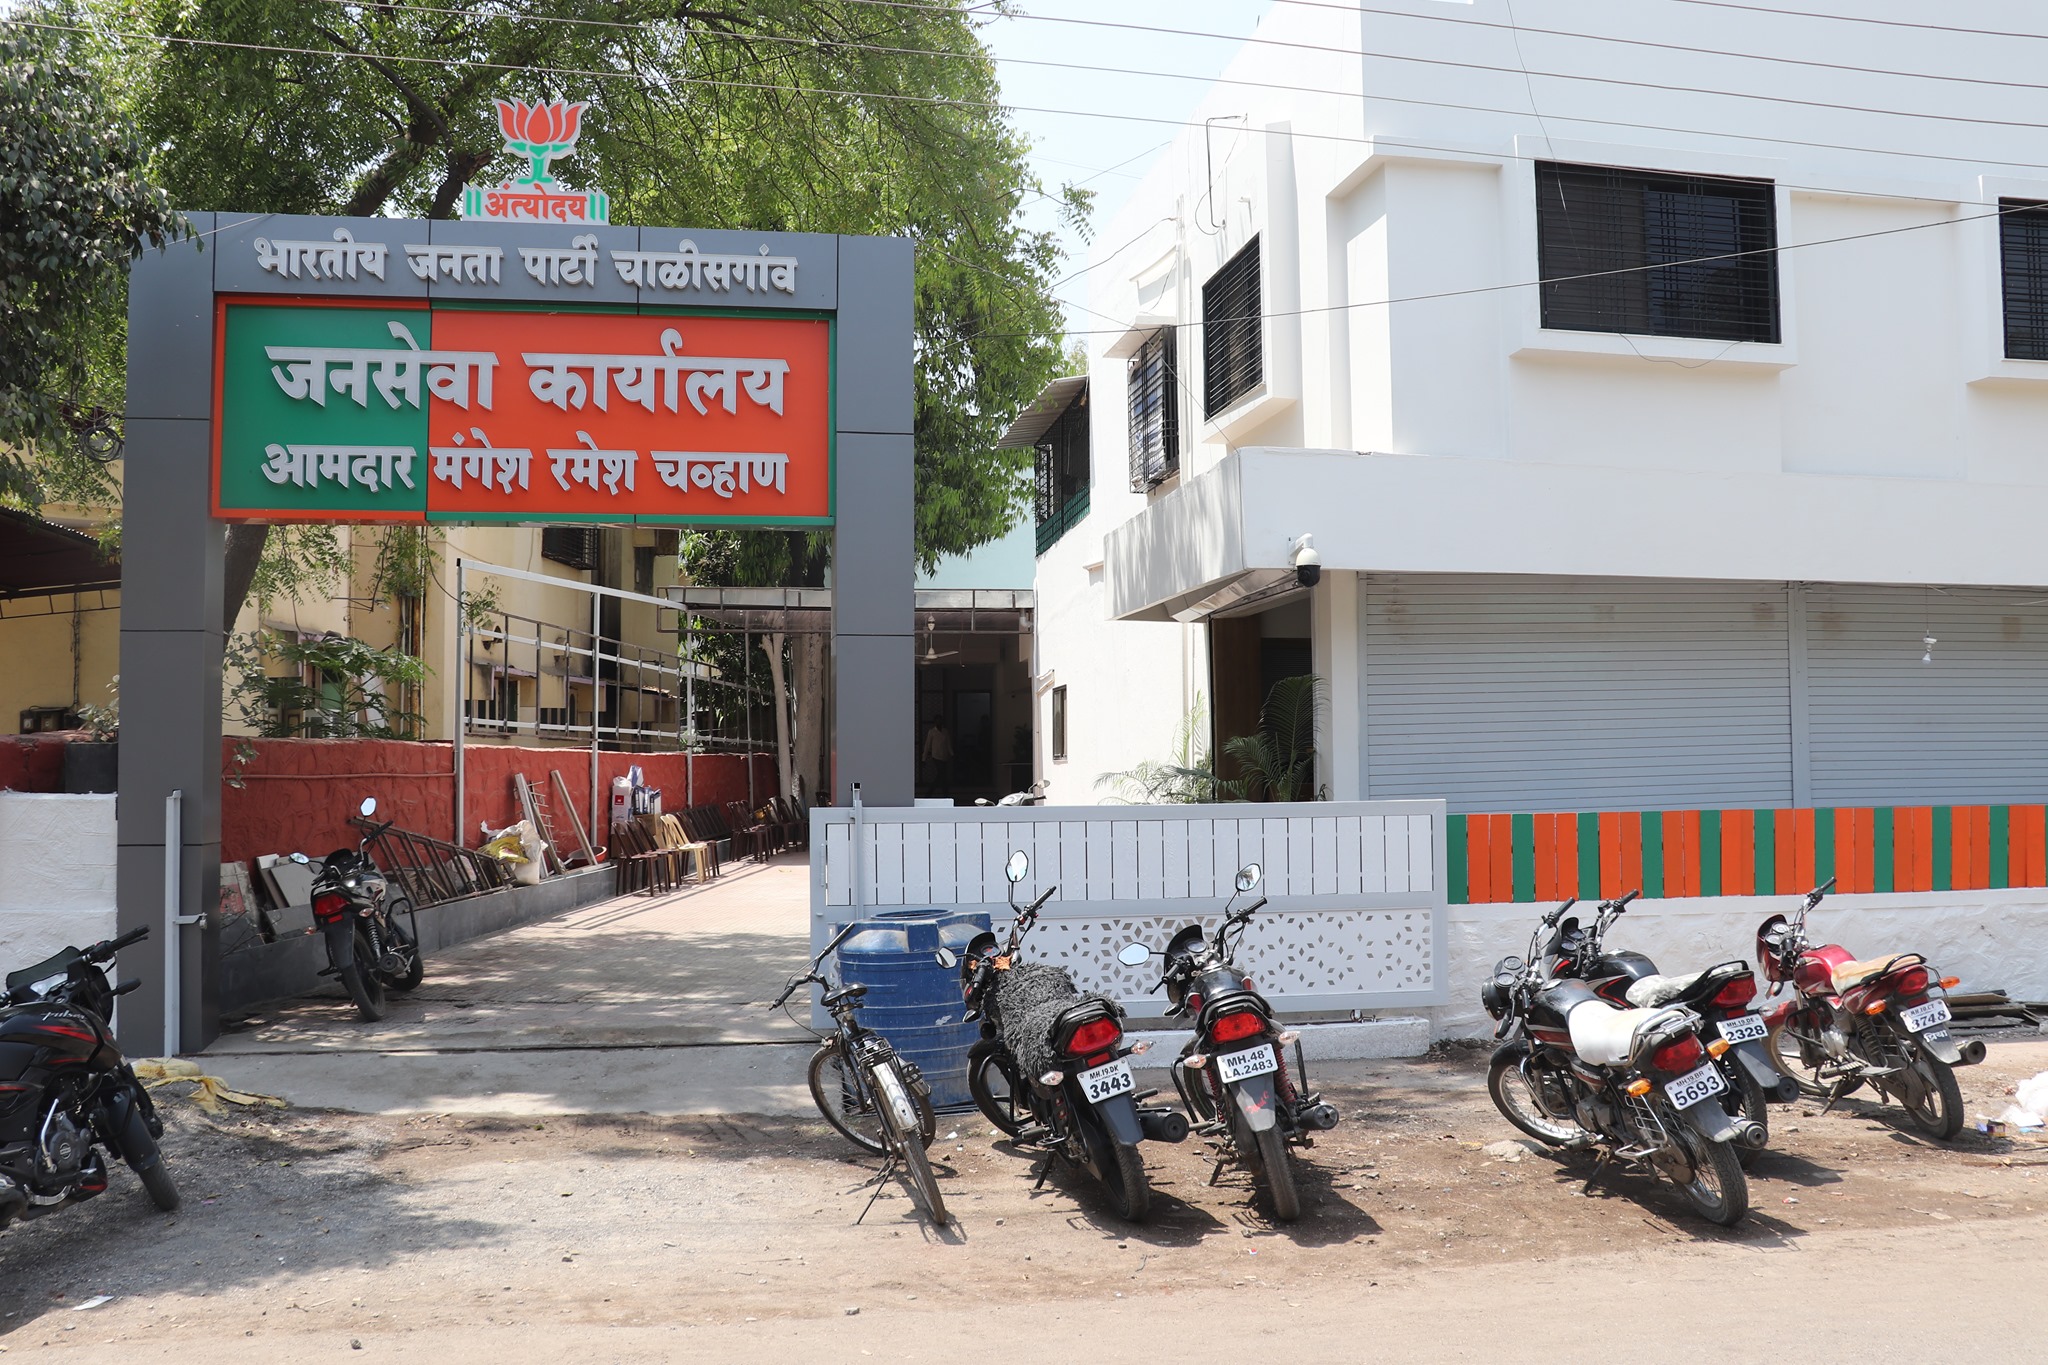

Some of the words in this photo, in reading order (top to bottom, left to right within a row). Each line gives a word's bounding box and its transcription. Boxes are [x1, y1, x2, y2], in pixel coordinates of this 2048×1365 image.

[485, 183, 588, 222] अंत्योदय
[254, 227, 389, 282] भारतीय
[403, 244, 504, 285] जनता
[518, 233, 599, 288] पार्टी
[610, 238, 799, 294] चाळीसगांव
[264, 321, 500, 411] जनसेवा
[521, 328, 790, 416] कार्यालय
[261, 443, 417, 493] आमदार
[429, 427, 533, 494] मंगेश
[546, 430, 639, 495] रमेश
[650, 450, 790, 498] चव्हाण
[1725, 1024, 1765, 1042] 2328
[1911, 1010, 1946, 1030] 3748
[1224, 1059, 1273, 1079] LA.2483
[1227, 1050, 1265, 1068] MH.48
[1090, 1073, 1131, 1099] 3443
[1674, 1076, 1720, 1106] 5693
